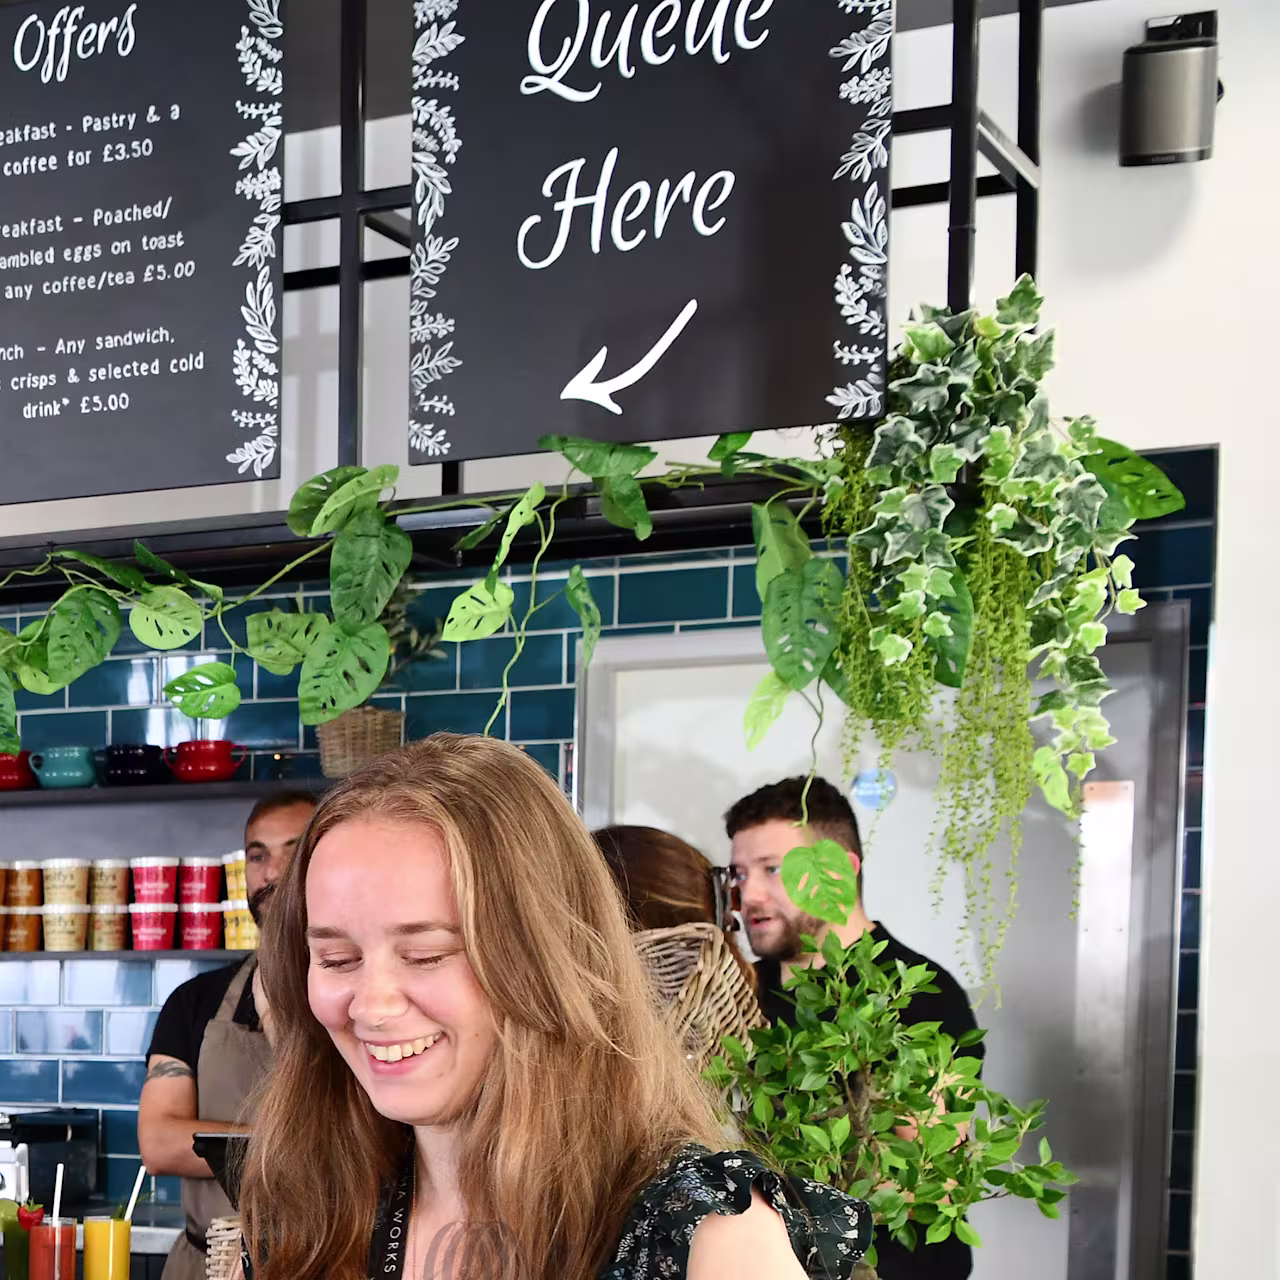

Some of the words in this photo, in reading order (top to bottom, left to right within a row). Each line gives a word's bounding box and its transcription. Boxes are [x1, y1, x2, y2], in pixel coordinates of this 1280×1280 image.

[14, 4, 136, 83] Offers
[520, 0, 773, 102] Queue
[83, 113, 136, 132] Pastry
[147, 105, 160, 123] &
[171, 104, 179, 120] a
[4, 156, 57, 176] coffee
[68, 151, 91, 166] for
[103, 139, 152, 162] £3.50
[94, 197, 172, 226] Poached/
[518, 147, 735, 269] Here
[64, 244, 101, 263] eggs
[111, 240, 131, 254] on
[142, 231, 184, 250] toast
[5, 285, 32, 300] any
[43, 271, 134, 294] coffee/tea
[144, 261, 195, 282] £5.00
[55, 339, 85, 354] Any
[96, 327, 174, 350] sandwich,
[11, 373, 56, 390] crisps
[68, 368, 79, 383] &
[89, 359, 159, 382] selected
[170, 352, 203, 373] cold
[80, 393, 129, 413] £5.00
[383, 1207, 405, 1273] WORKS
